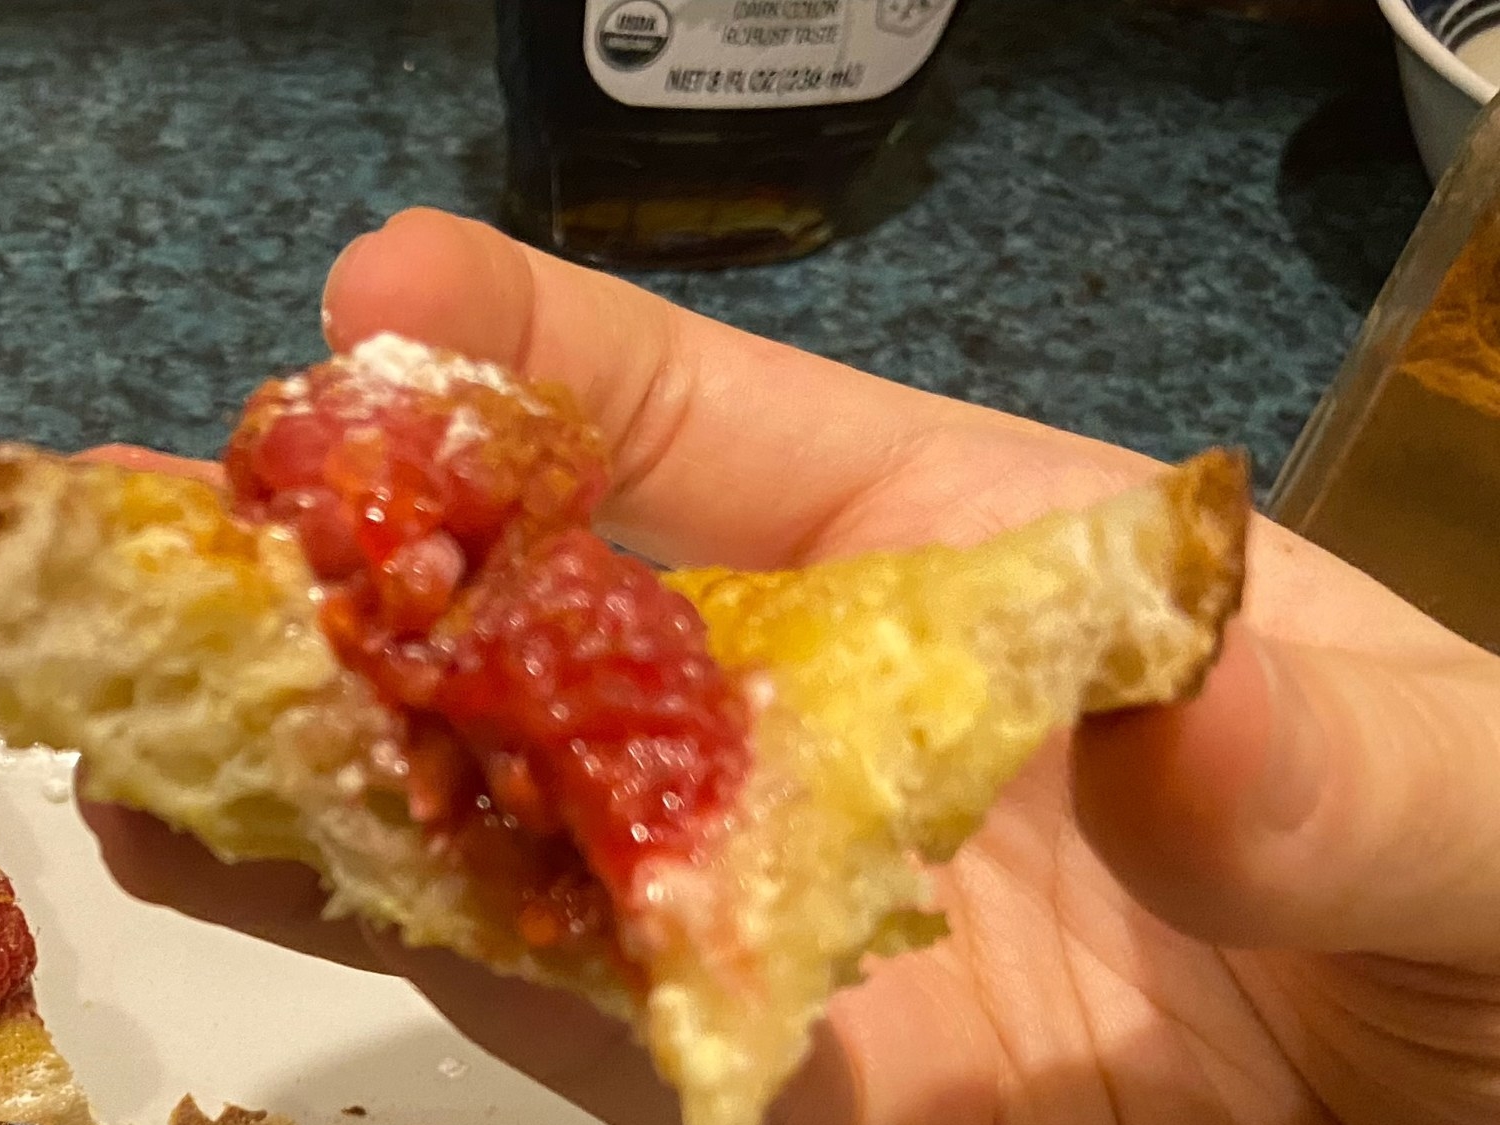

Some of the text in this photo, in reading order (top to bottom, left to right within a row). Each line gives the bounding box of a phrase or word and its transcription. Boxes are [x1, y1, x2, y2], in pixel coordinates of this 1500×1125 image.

[665, 69, 706, 93] NET
[725, 70, 746, 93] FL
[749, 70, 777, 93] OZ
